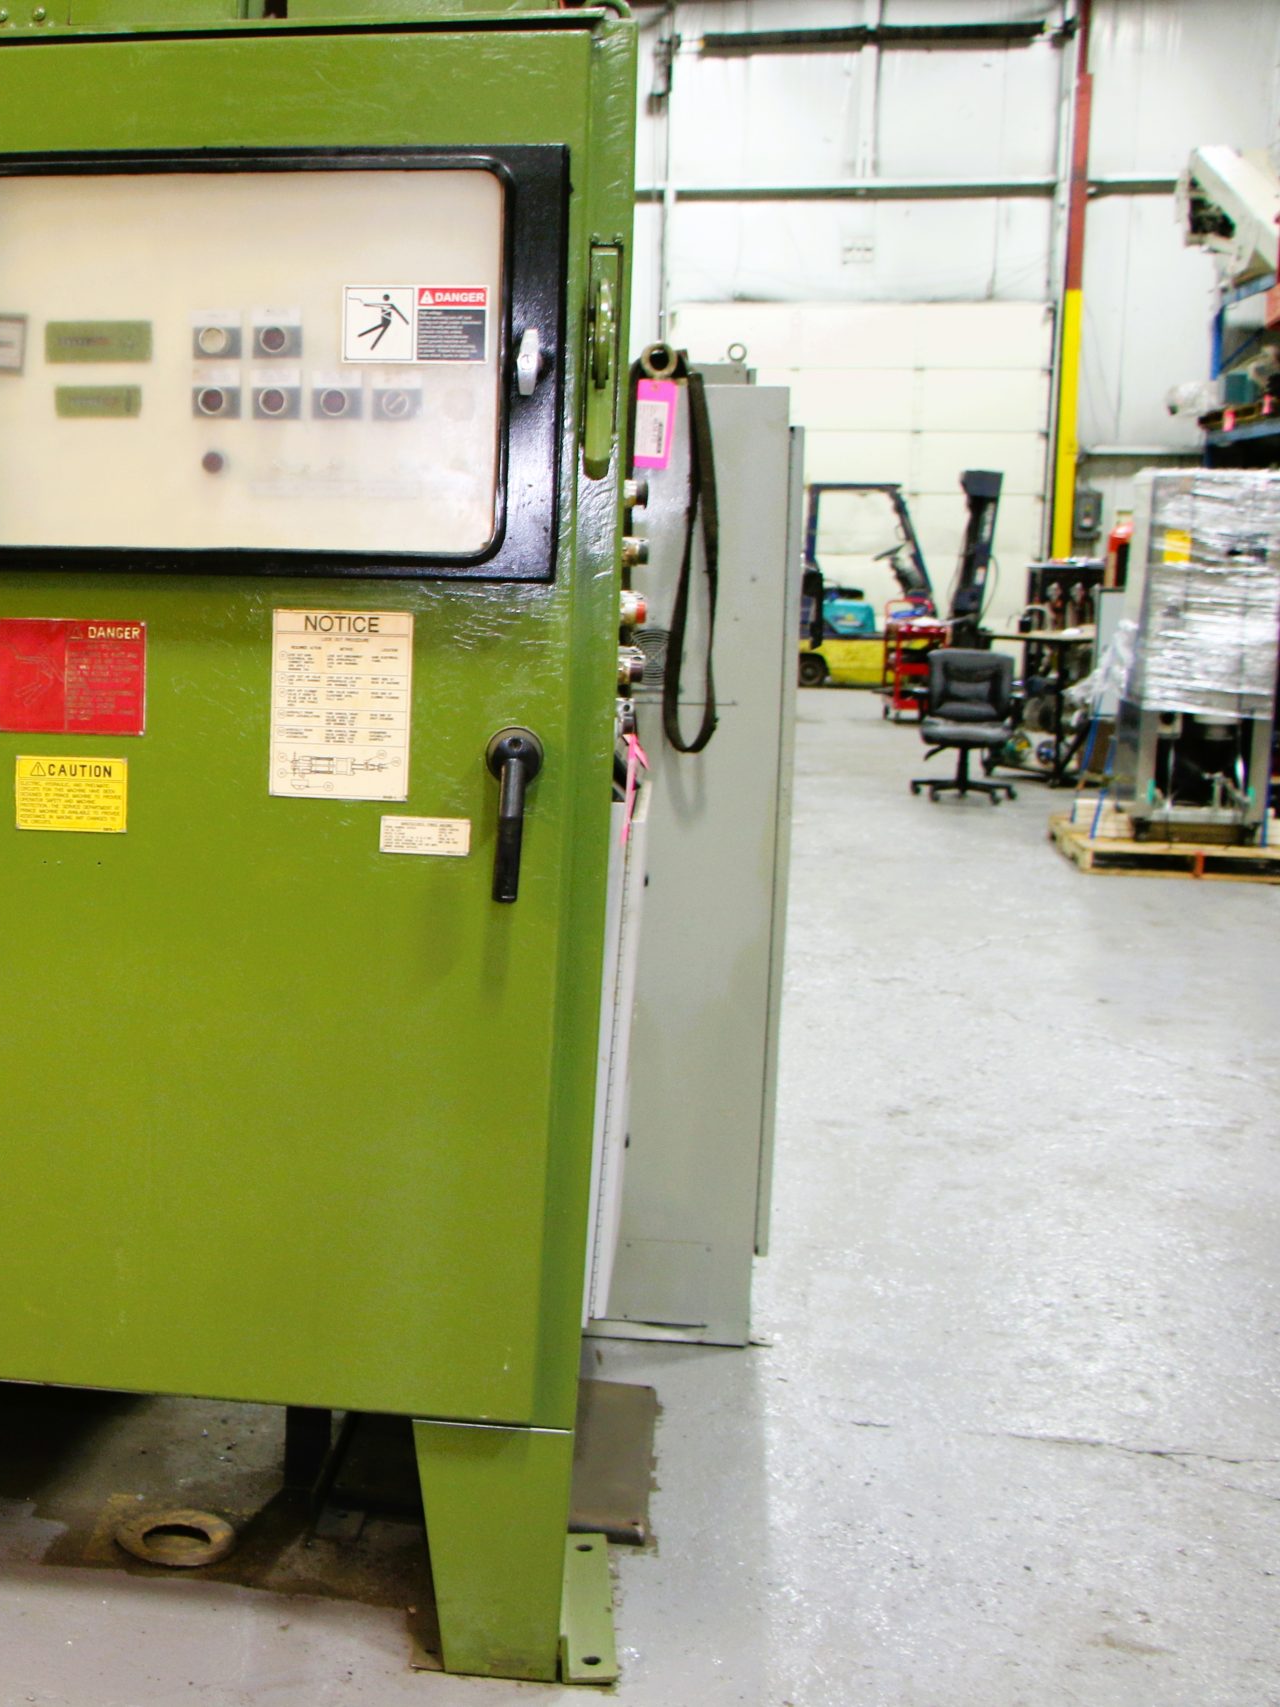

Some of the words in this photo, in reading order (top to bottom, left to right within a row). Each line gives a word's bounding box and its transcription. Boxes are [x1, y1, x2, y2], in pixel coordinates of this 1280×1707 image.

[434, 292, 485, 302] DANGER
[305, 615, 380, 633] NOTICE
[88, 626, 141, 640] DANGER
[48, 764, 112, 778] CAUTION
